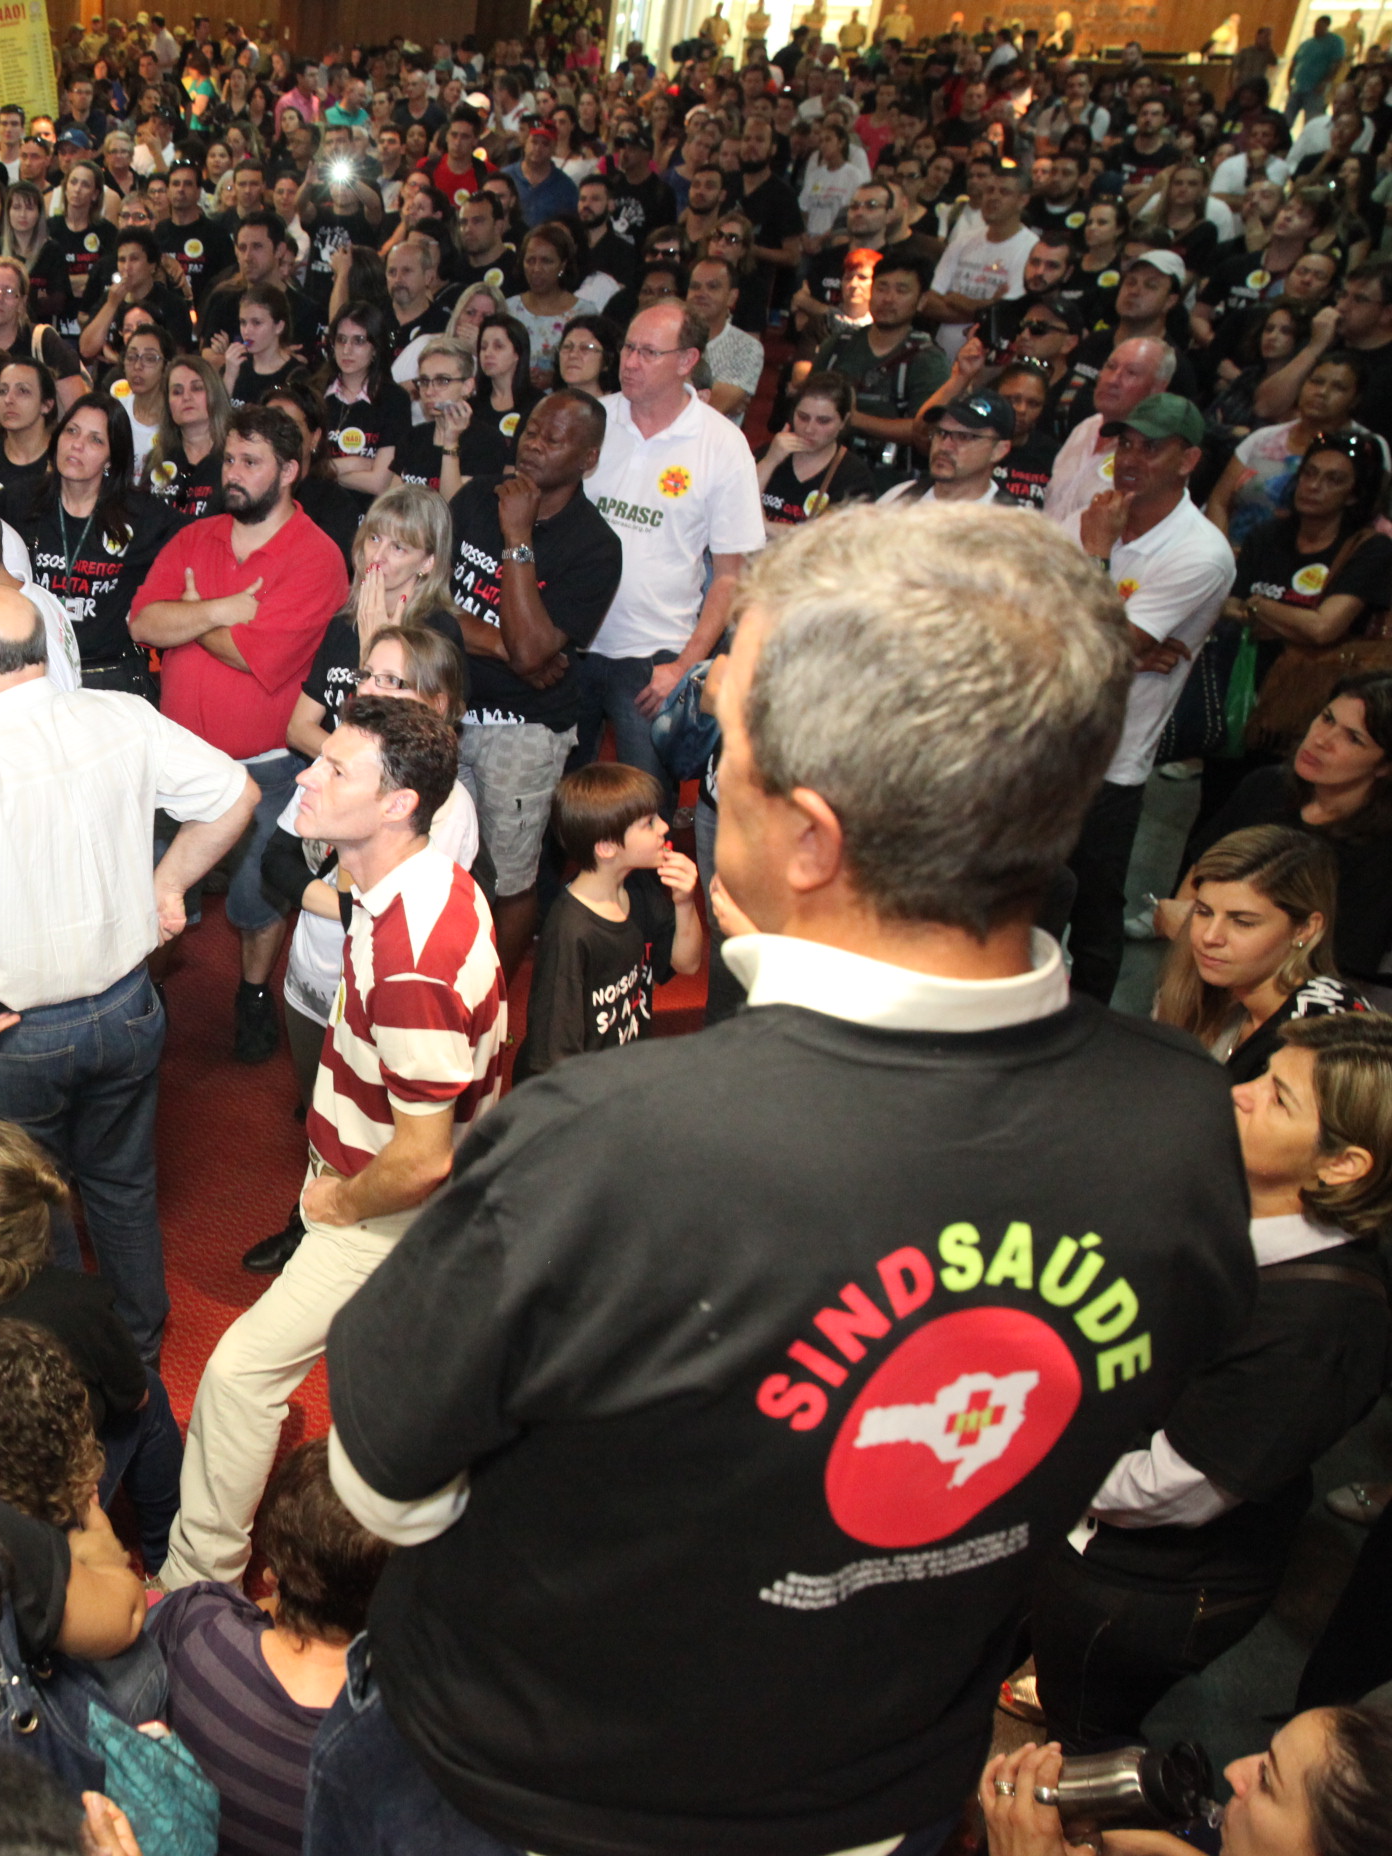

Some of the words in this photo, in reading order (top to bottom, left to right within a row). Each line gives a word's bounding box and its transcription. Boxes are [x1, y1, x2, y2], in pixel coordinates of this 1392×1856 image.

[596, 496, 664, 528] APRASC
[460, 540, 497, 575] NOSSOS
[91, 578, 119, 597] FAZ
[463, 571, 476, 592] A
[755, 1221, 1152, 1431] SINDSAÚDE
